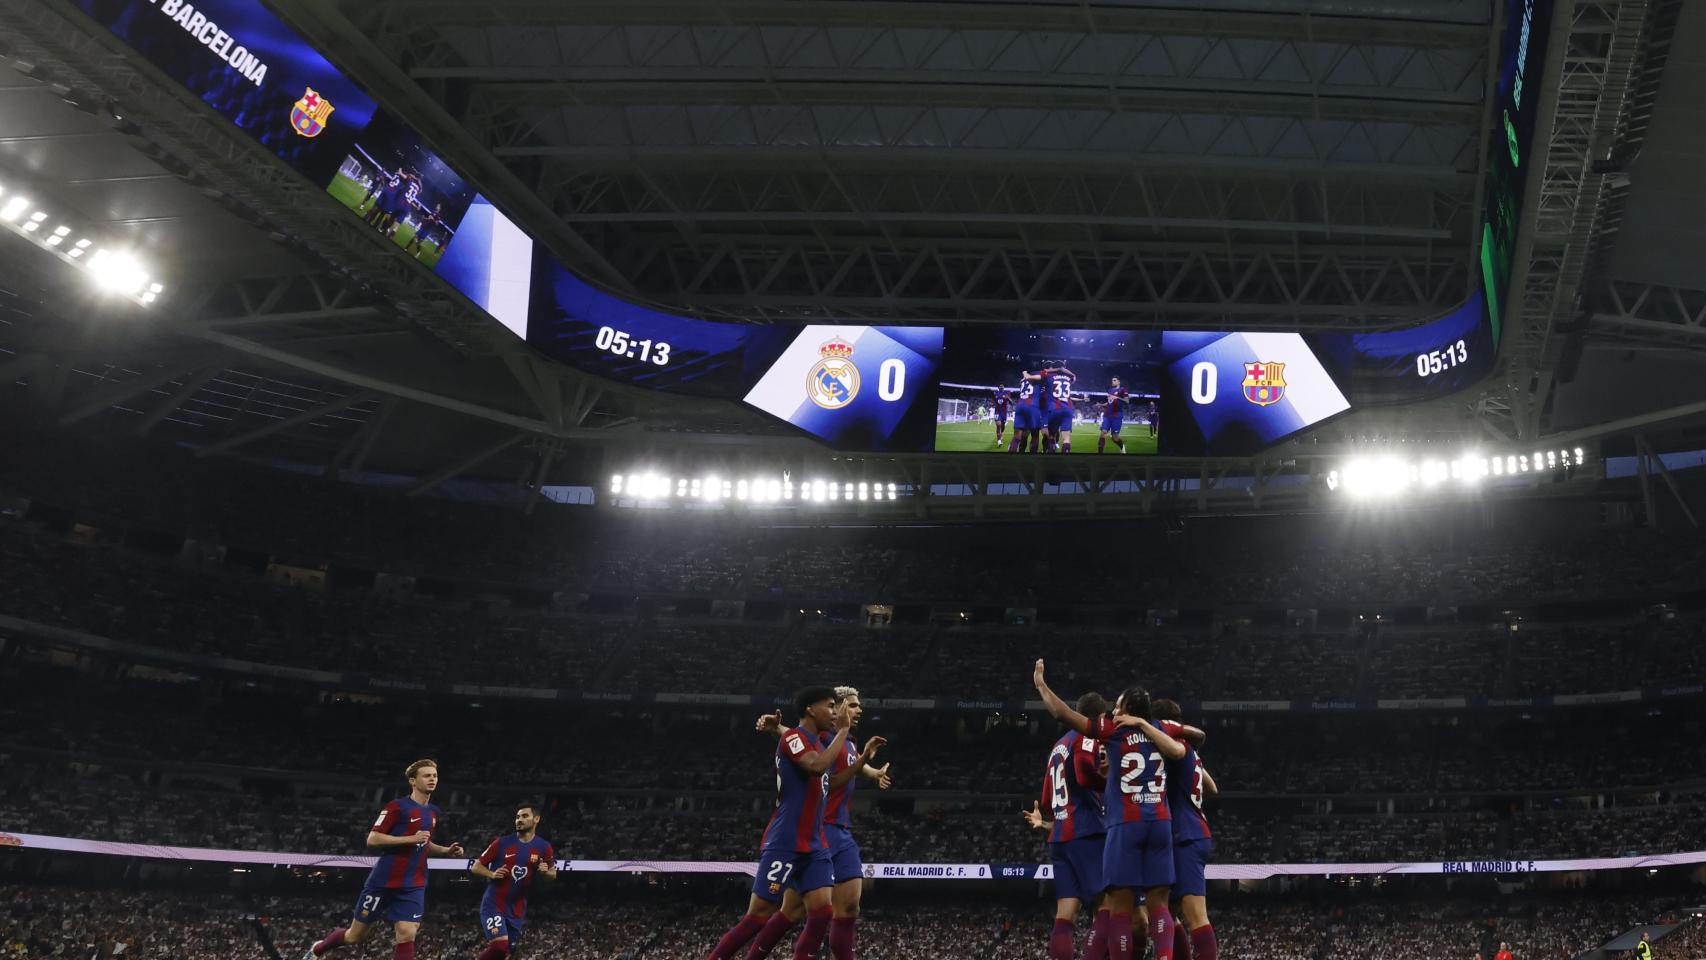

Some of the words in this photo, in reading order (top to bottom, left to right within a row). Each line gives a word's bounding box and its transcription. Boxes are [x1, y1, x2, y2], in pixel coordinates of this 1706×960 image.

[161, 0, 268, 86] BARCELONA
[595, 326, 671, 366] 05:13
[1417, 339, 1467, 377] 05:13
[878, 358, 906, 401] 0
[1052, 381, 1071, 398] 33
[1191, 361, 1218, 405] 0
[1126, 732, 1149, 746] KOU
[1120, 752, 1166, 794] 23
[1050, 763, 1068, 808] 15
[767, 860, 793, 884] 27
[883, 867, 905, 876] REAL
[908, 867, 943, 876] MADRID
[979, 867, 985, 877] 0
[1002, 867, 1025, 877] 05:13
[1042, 867, 1049, 877] 0
[1443, 862, 1469, 873] REAL
[1472, 861, 1512, 873] MADRID
[362, 895, 381, 912] 21
[486, 915, 503, 930] 22
